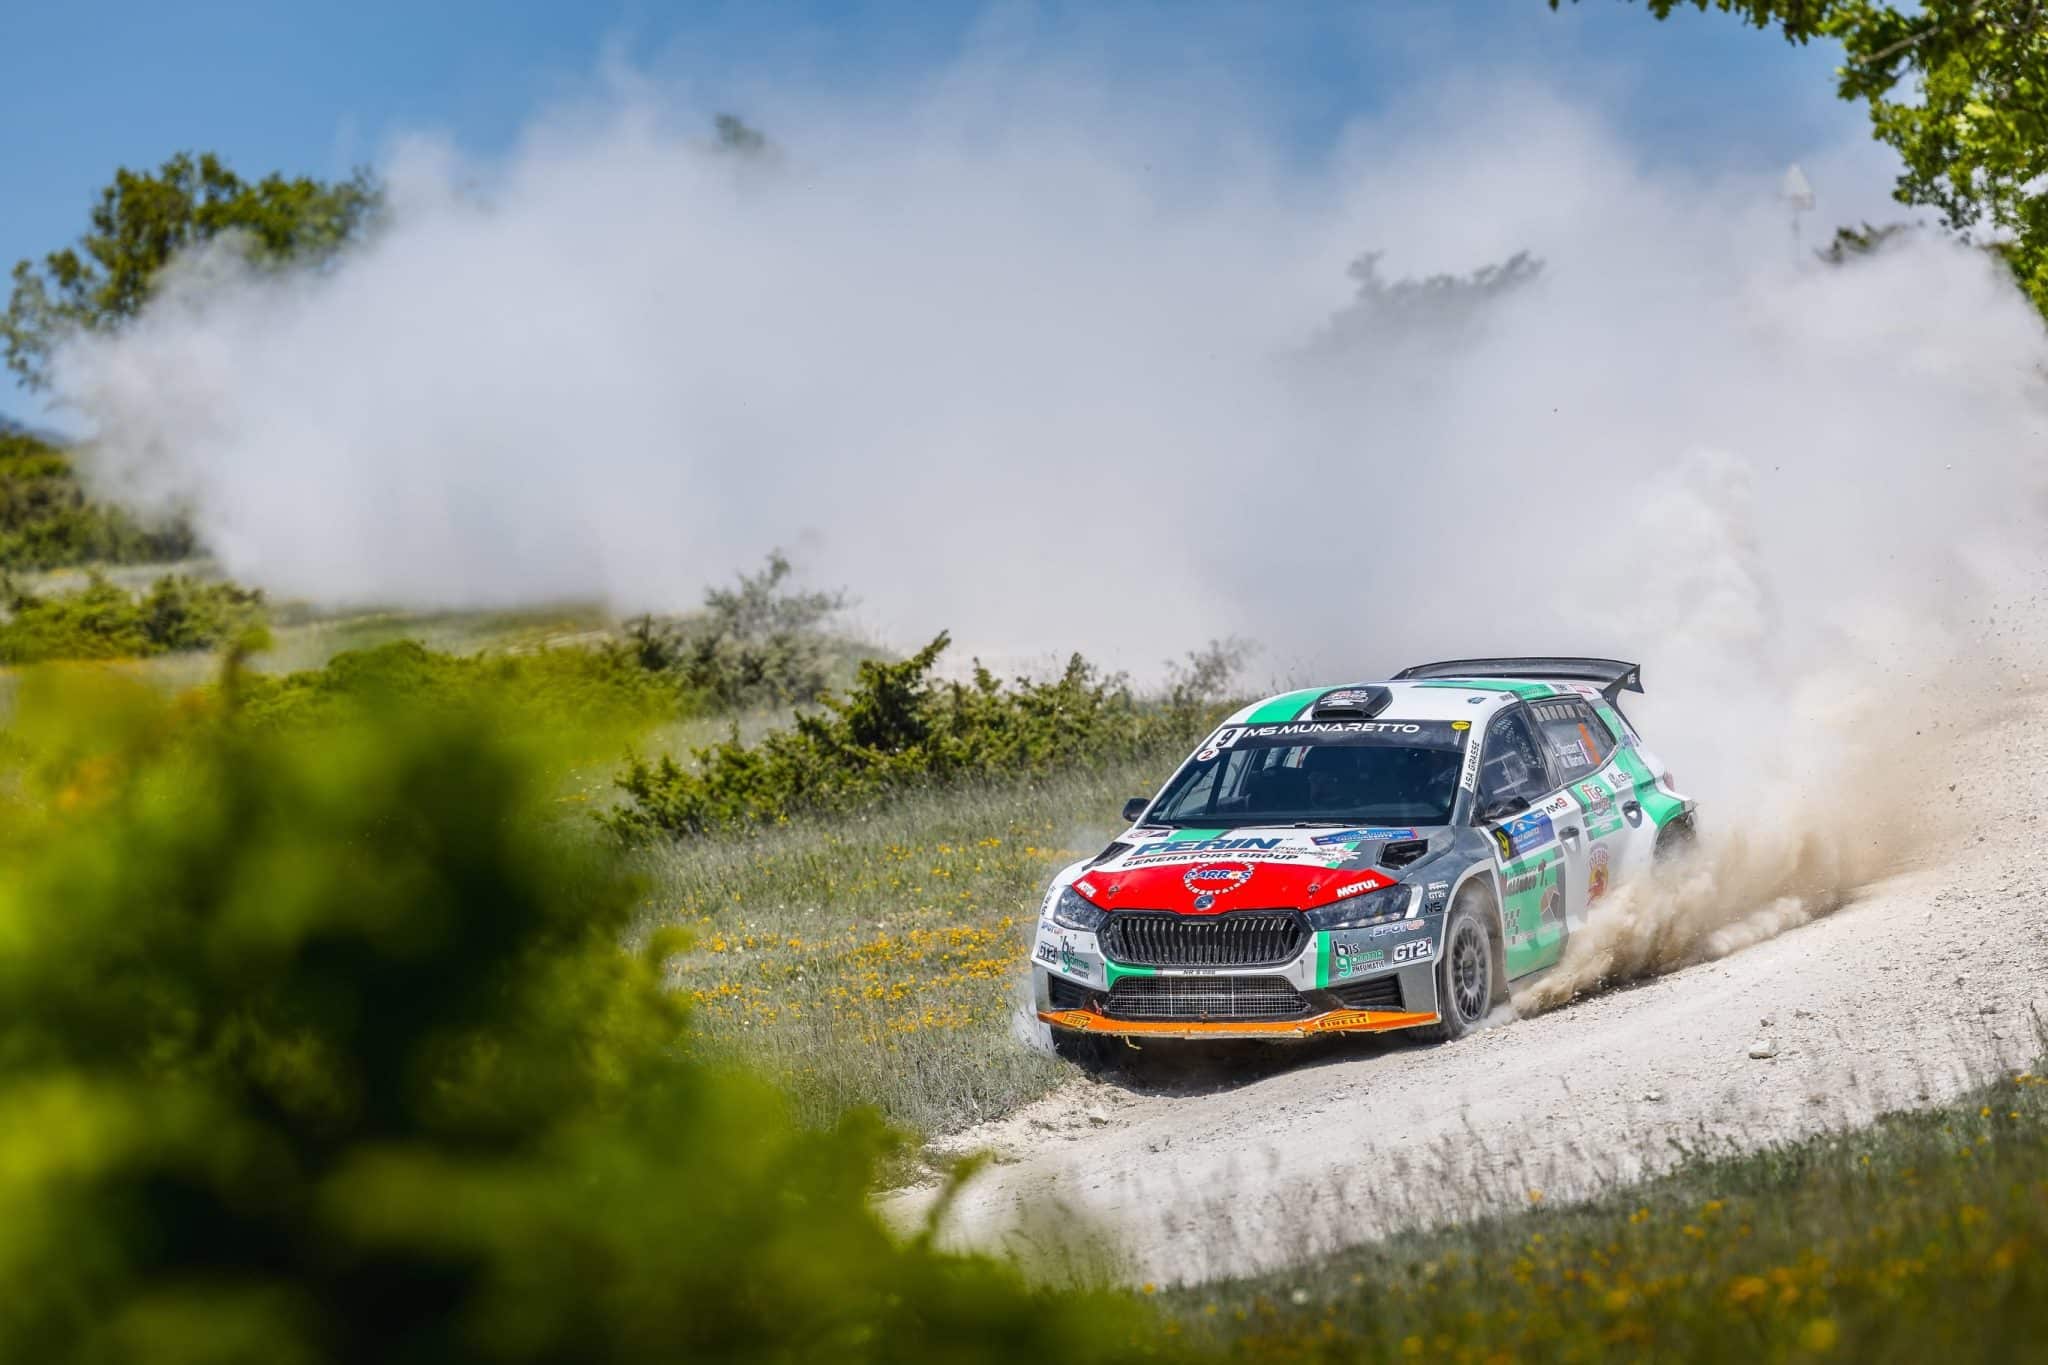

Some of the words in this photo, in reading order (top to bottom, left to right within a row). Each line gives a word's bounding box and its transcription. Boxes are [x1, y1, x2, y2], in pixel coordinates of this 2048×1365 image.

[1216, 728, 1239, 748] 9
[1243, 726, 1279, 738] MS
[1279, 723, 1420, 735] MUNARETTO
[1132, 838, 1283, 856] PERIN
[1122, 853, 1233, 867] GENERATORS
[1237, 852, 1299, 861] GROUP
[1336, 880, 1379, 897] MOTUL
